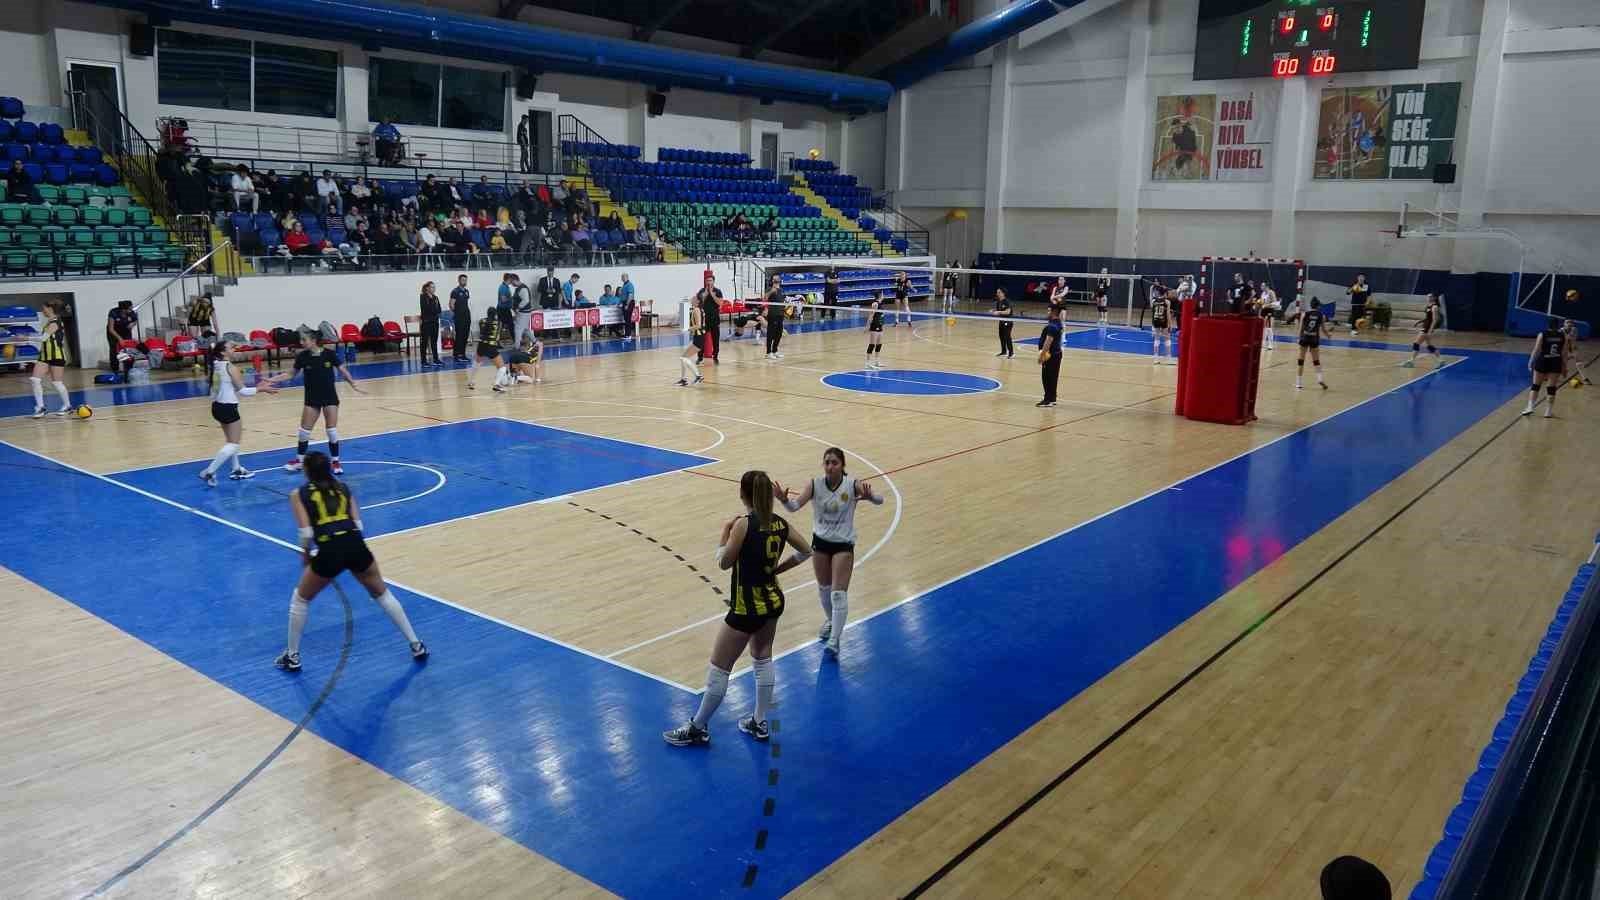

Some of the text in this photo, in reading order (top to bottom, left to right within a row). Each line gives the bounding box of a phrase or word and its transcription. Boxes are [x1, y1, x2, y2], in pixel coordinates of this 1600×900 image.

[1285, 17, 1295, 30] 0
[1323, 15, 1332, 27] 0
[1277, 59, 1299, 74] 00
[1313, 56, 1335, 72] 00
[766, 535, 782, 573] 9
